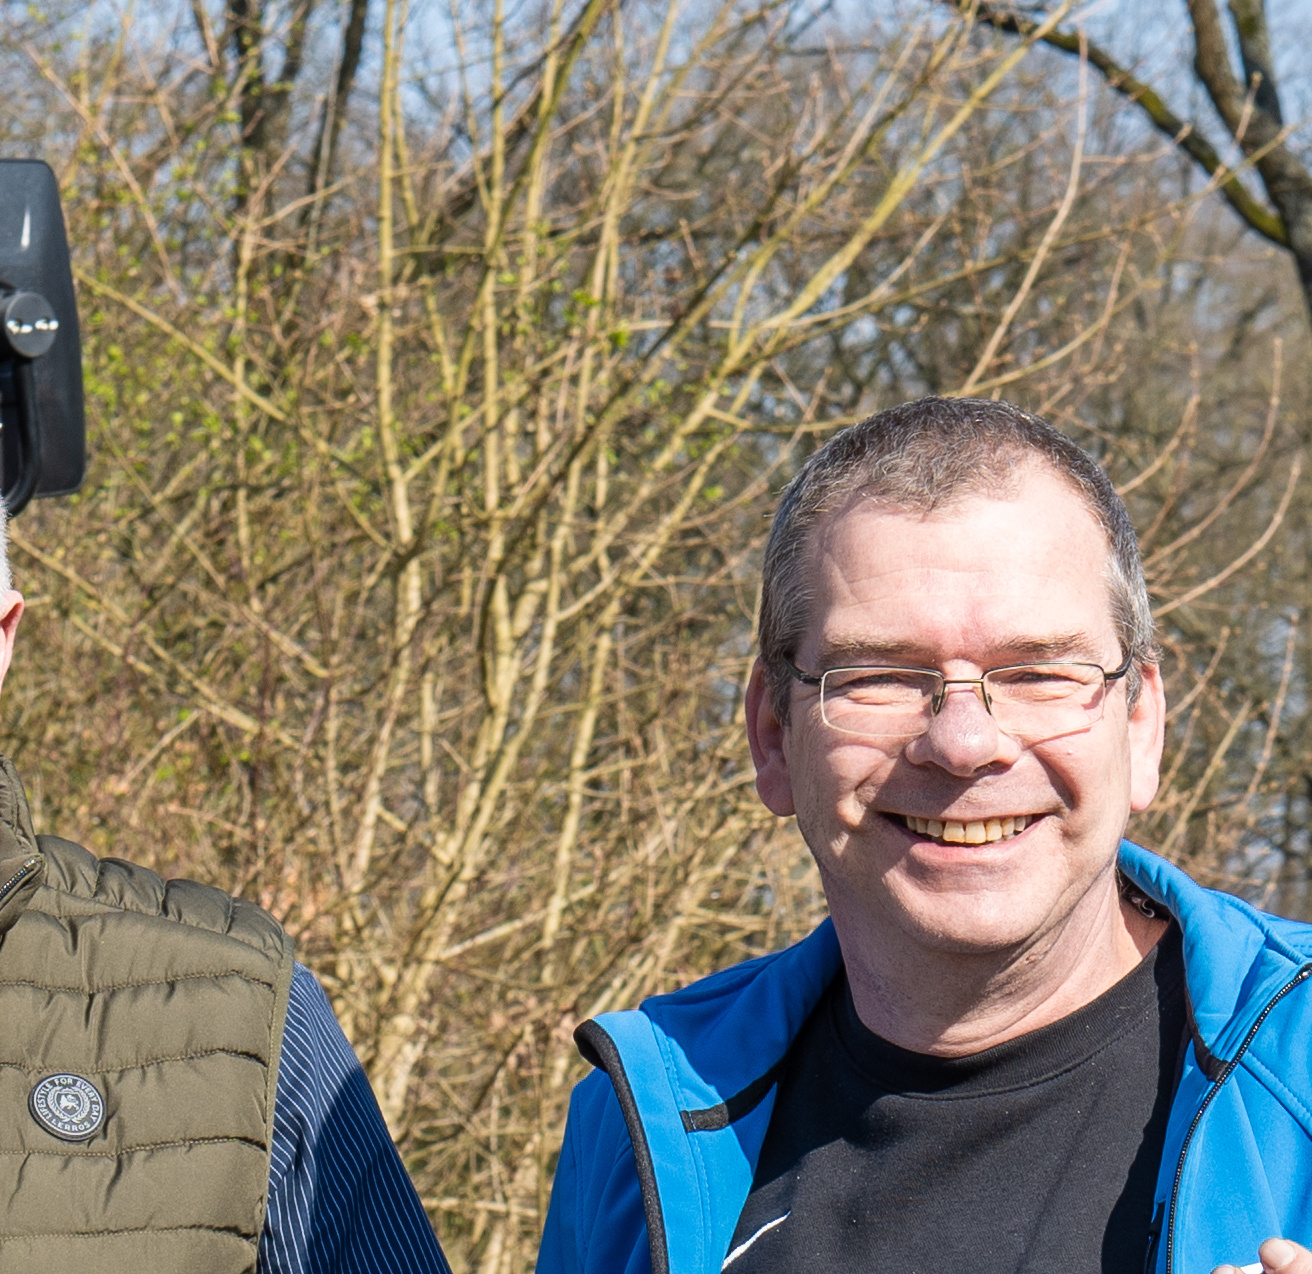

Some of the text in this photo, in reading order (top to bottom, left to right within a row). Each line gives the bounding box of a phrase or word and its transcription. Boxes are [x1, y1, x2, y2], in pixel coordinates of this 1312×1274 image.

[37, 1078, 100, 1122] LIFESTYLE FOR EVERY DAY
[51, 1118, 90, 1131] LERROS
